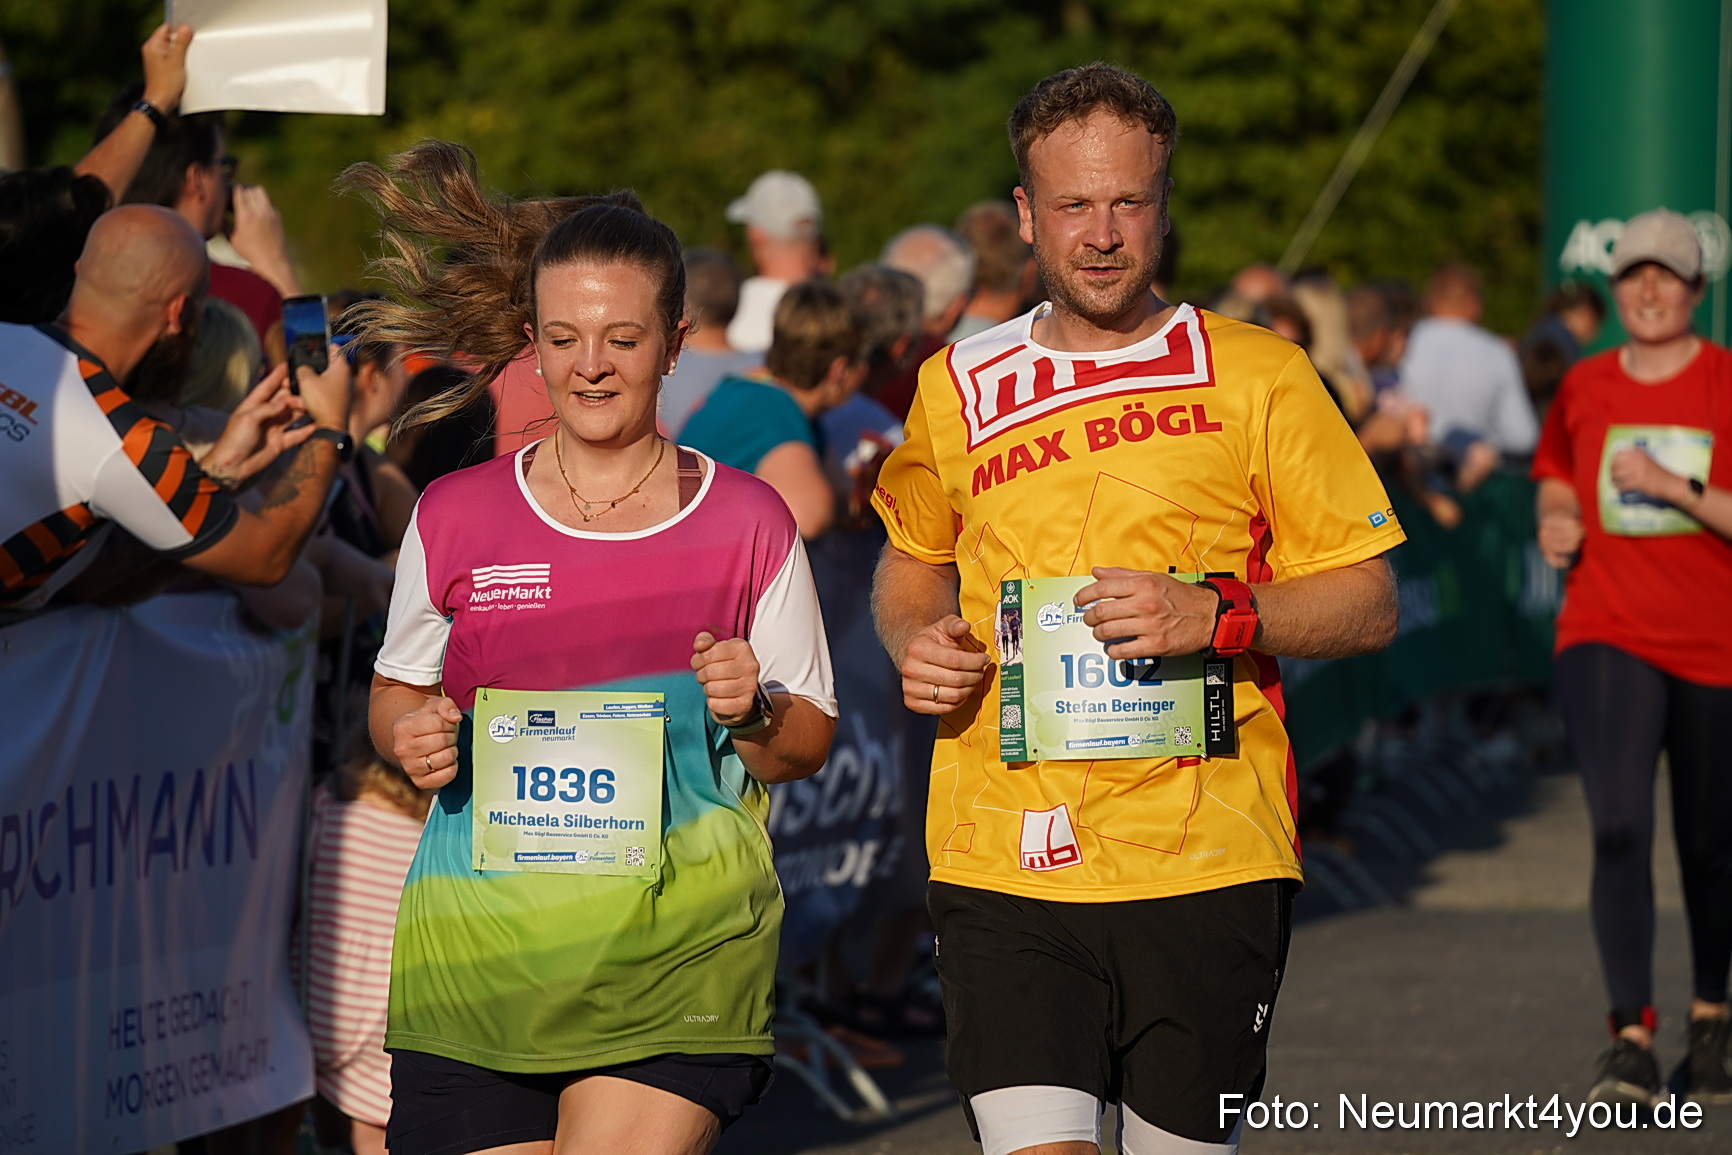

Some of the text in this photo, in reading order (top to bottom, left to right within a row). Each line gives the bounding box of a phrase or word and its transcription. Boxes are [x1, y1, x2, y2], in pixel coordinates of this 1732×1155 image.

[1559, 218, 1625, 274] AO
[972, 401, 1223, 498] MAX BÖGL
[469, 585, 552, 603] NeuerMarkt
[1002, 594, 1019, 604] AOK
[517, 602, 546, 610] genießen
[1060, 653, 1162, 688] 1602
[1055, 698, 1175, 714] Stefan Beringer
[1210, 690, 1221, 741] HILTL
[520, 726, 576, 736] Firmenlauf
[1068, 739, 1126, 749] firmenlauf.bayern
[513, 766, 616, 804] 1836
[489, 811, 645, 831] Michaela Silberhorn
[517, 853, 573, 862] firmenlauf.bayern
